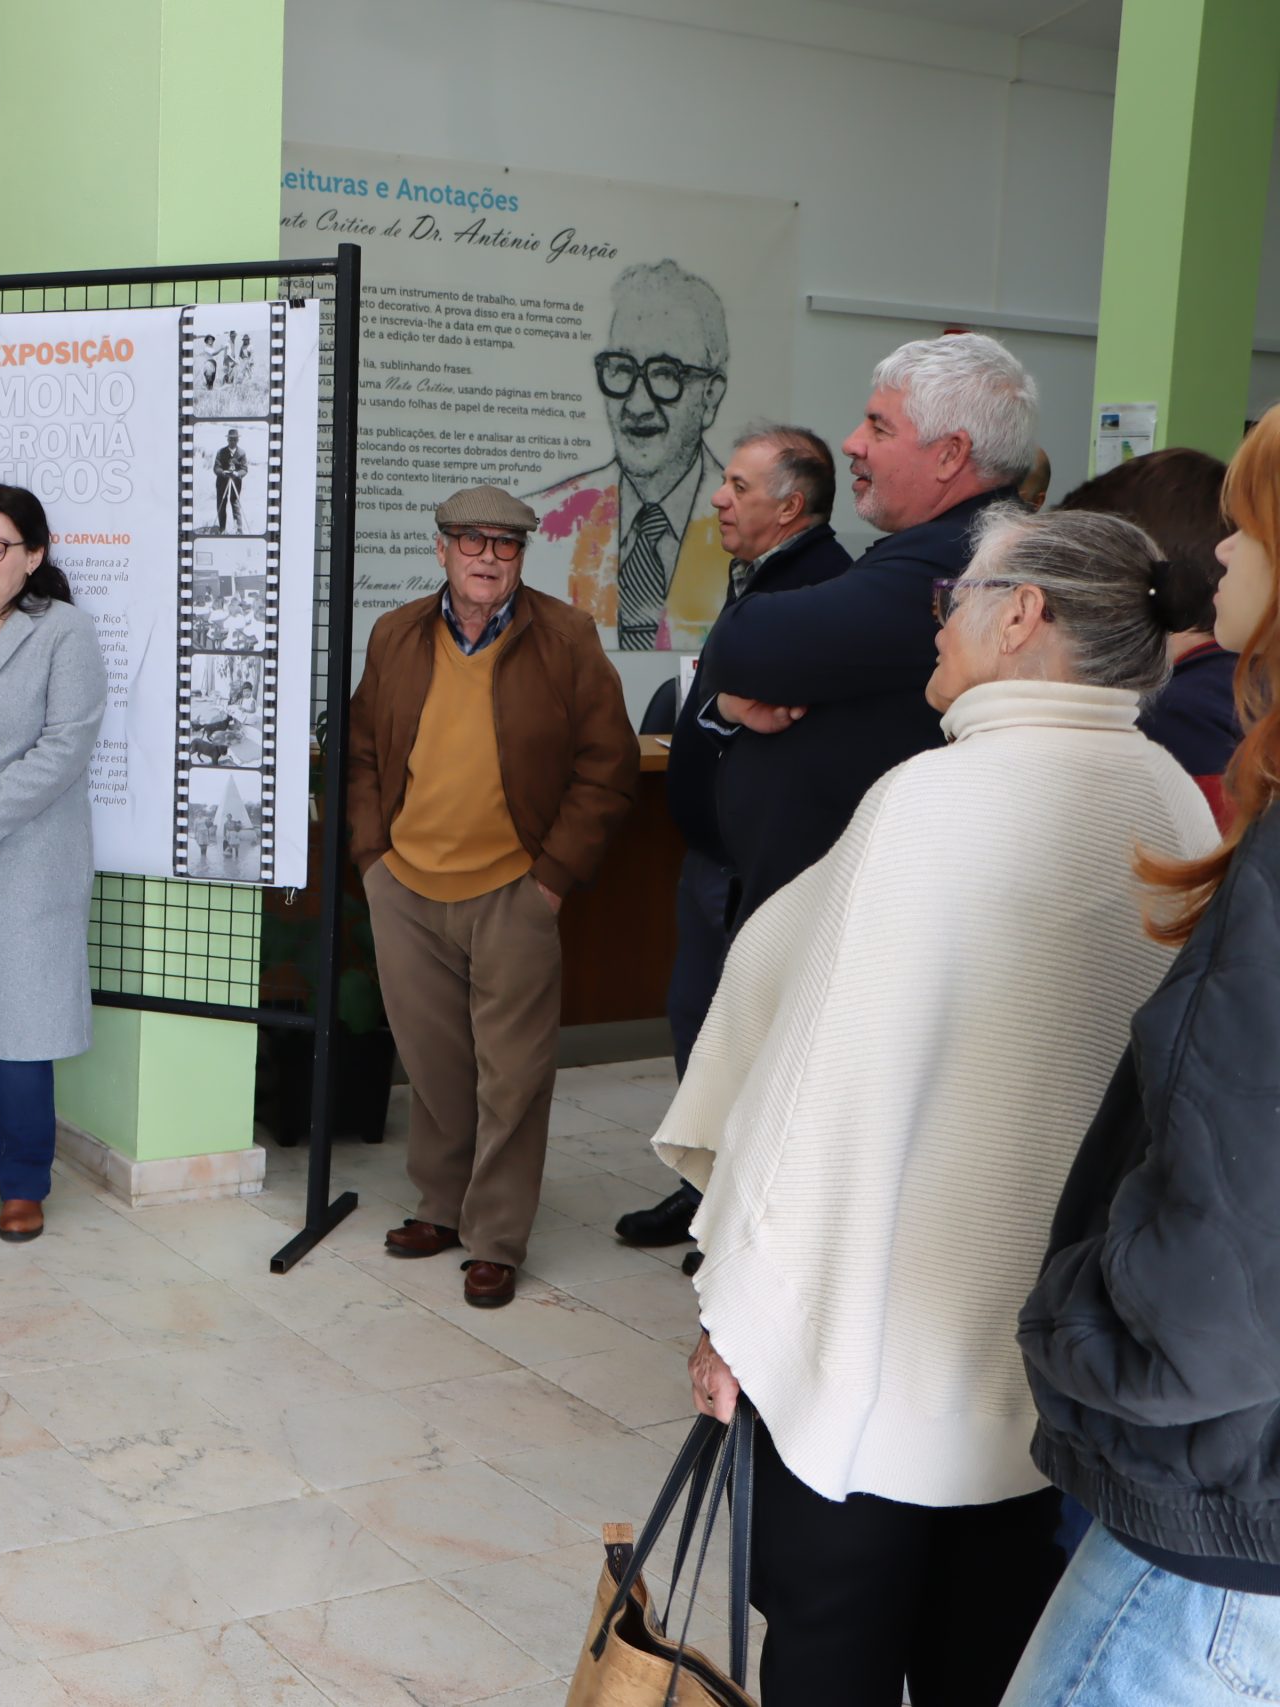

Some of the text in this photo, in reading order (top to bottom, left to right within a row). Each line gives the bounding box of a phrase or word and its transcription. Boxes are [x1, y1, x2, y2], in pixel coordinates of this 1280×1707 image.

[281, 168, 518, 213] eituras e Anotações
[280, 211, 308, 228] nto
[380, 218, 401, 237] de
[409, 214, 442, 242] Dr.
[454, 217, 540, 251] António
[545, 227, 618, 264] Garção
[362, 285, 377, 294] era
[380, 287, 396, 295] um
[399, 288, 459, 300] instrumento
[462, 291, 473, 302] de
[520, 299, 540, 308] uma
[543, 298, 570, 310] forma
[572, 301, 583, 311] de
[360, 300, 375, 309] eto
[435, 304, 442, 313] A
[444, 306, 471, 316] prova
[474, 307, 498, 318] disso
[501, 311, 515, 320] era
[518, 312, 523, 320] a
[526, 311, 553, 323] forma
[556, 316, 582, 325] como
[370, 315, 377, 324] e
[379, 316, 443, 328] inscrevia-lhe
[445, 321, 451, 329] a
[453, 320, 474, 331] data
[476, 323, 492, 332] em
[494, 325, 512, 335] que
[514, 326, 521, 335] o
[523, 328, 570, 339] começava
[572, 331, 578, 340] a
[363, 328, 375, 338] de
[378, 331, 384, 339] a
[386, 330, 419, 342] edição
[422, 333, 435, 342] ter
[438, 334, 462, 344] dado
[465, 336, 470, 346] à
[380, 360, 440, 372] sublinhando
[359, 380, 381, 389] uma
[458, 386, 493, 396] usando
[495, 388, 531, 399] páginas
[534, 391, 548, 399] em
[551, 390, 582, 401] branco
[369, 398, 405, 408] usando
[408, 398, 437, 410] folhas
[440, 400, 451, 410] de
[455, 402, 480, 413] papel
[483, 403, 494, 413] de
[497, 405, 528, 415] receita
[569, 410, 585, 419] que
[439, 429, 451, 440] de
[454, 430, 466, 440] ler
[468, 432, 474, 441] e
[477, 432, 513, 442] analisar
[515, 435, 525, 443] as
[528, 435, 560, 445] críticas
[563, 436, 568, 446] à
[571, 437, 590, 447] obra
[409, 444, 419, 452] os
[422, 445, 461, 454] recortes
[464, 445, 507, 456] dobrados
[510, 448, 540, 458] dentro
[543, 448, 555, 459] do
[360, 456, 541, 472] revelando quase sempre um profundo
[362, 472, 367, 480] e
[370, 470, 383, 480] do
[386, 472, 429, 482] contexto
[432, 473, 468, 483] literário
[471, 476, 510, 485] nacional
[513, 478, 518, 486] e
[357, 500, 441, 514] tros tipos de publ
[64, 534, 130, 544] CARVALHO
[356, 529, 387, 540] poesia
[390, 529, 400, 540] às
[354, 543, 436, 555] dicina, da psicolo
[65, 557, 83, 567] Casa
[86, 558, 114, 568] Branca
[116, 560, 121, 568] a
[123, 558, 130, 568] 2
[69, 571, 128, 582] faleceu na vila
[72, 585, 110, 596] de 2000.
[98, 630, 128, 638] amente
[101, 642, 128, 653] grafia,
[114, 658, 128, 666] sua
[108, 684, 128, 694] ndes
[114, 700, 128, 708] em
[103, 740, 128, 750] Bento
[97, 752, 110, 763] fez
[111, 755, 128, 764] esta
[108, 769, 128, 779] para
[93, 794, 126, 806] Arquivo
